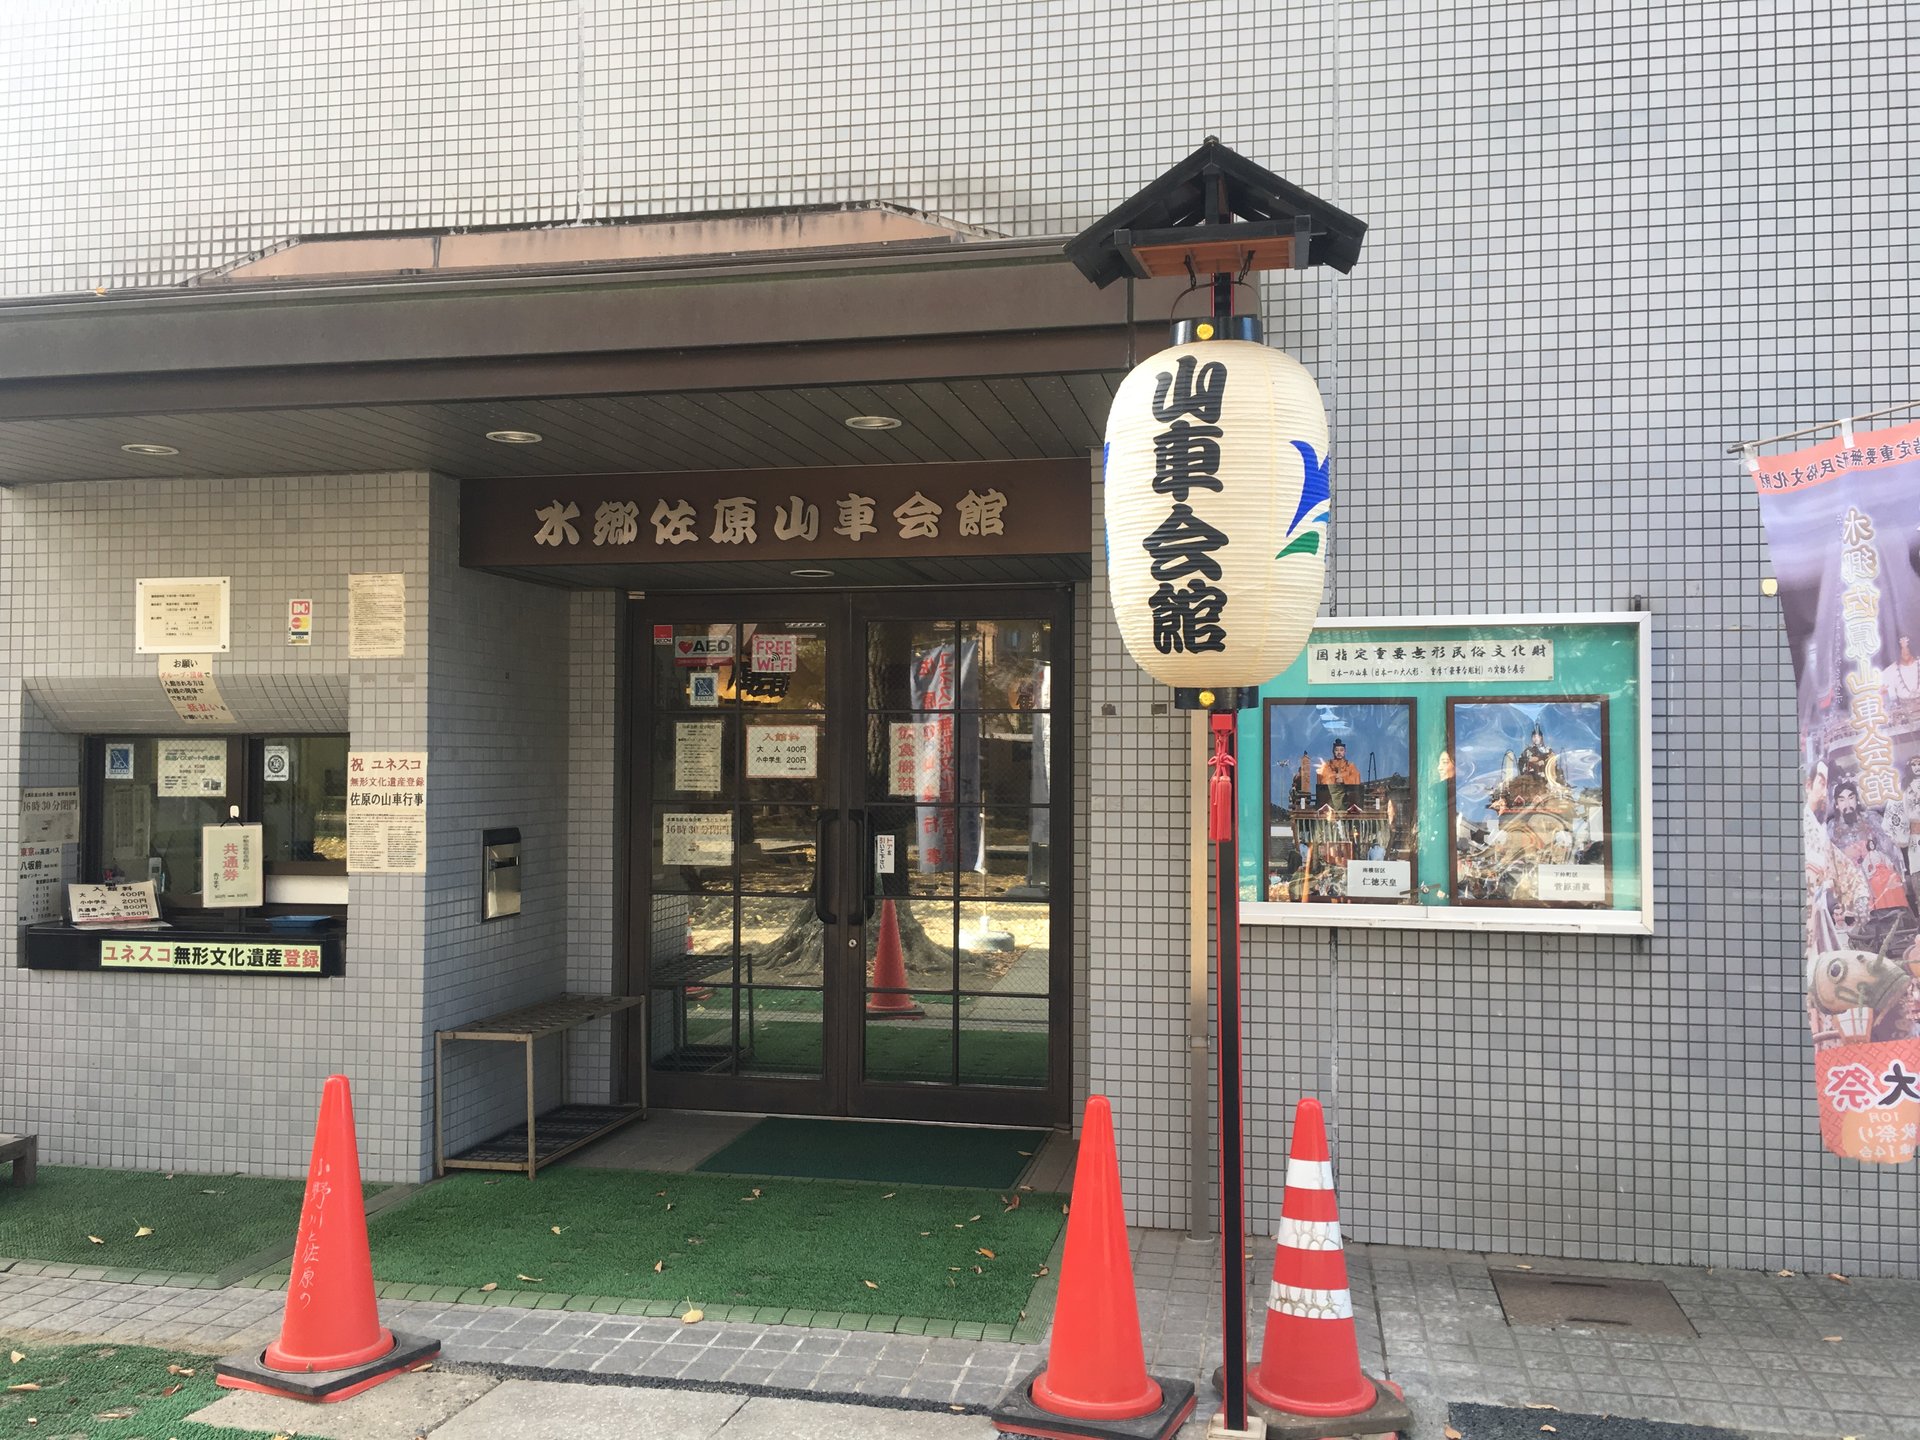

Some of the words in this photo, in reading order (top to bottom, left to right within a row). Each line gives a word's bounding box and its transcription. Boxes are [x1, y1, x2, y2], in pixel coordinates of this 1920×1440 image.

[1142, 355, 1229, 654] 山車会館
[533, 488, 1009, 547] 水郷佐原山車会館
[693, 639, 730, 652] AED
[755, 640, 792, 655] FREE
[1316, 644, 1547, 661] 国指定重要無形民俗文化財
[173, 659, 198, 668] お願い
[756, 657, 793, 671] Wi-Fi
[763, 732, 800, 742] 入館料
[786, 745, 807, 753] 400円
[350, 757, 364, 771] 祝
[371, 758, 421, 771] ユネスコ
[755, 756, 782, 764] 小中学生
[786, 756, 807, 764] 200円
[350, 777, 425, 787] 無形文化遺産登録
[350, 792, 424, 806] 佐原の山車行事
[223, 842, 239, 881] 共通券
[1362, 876, 1397, 887] 仁徳天皇
[103, 944, 320, 969] ユネスコ無形文化遺産登録
[298, 1157, 332, 1311] 小野川と佐原の
